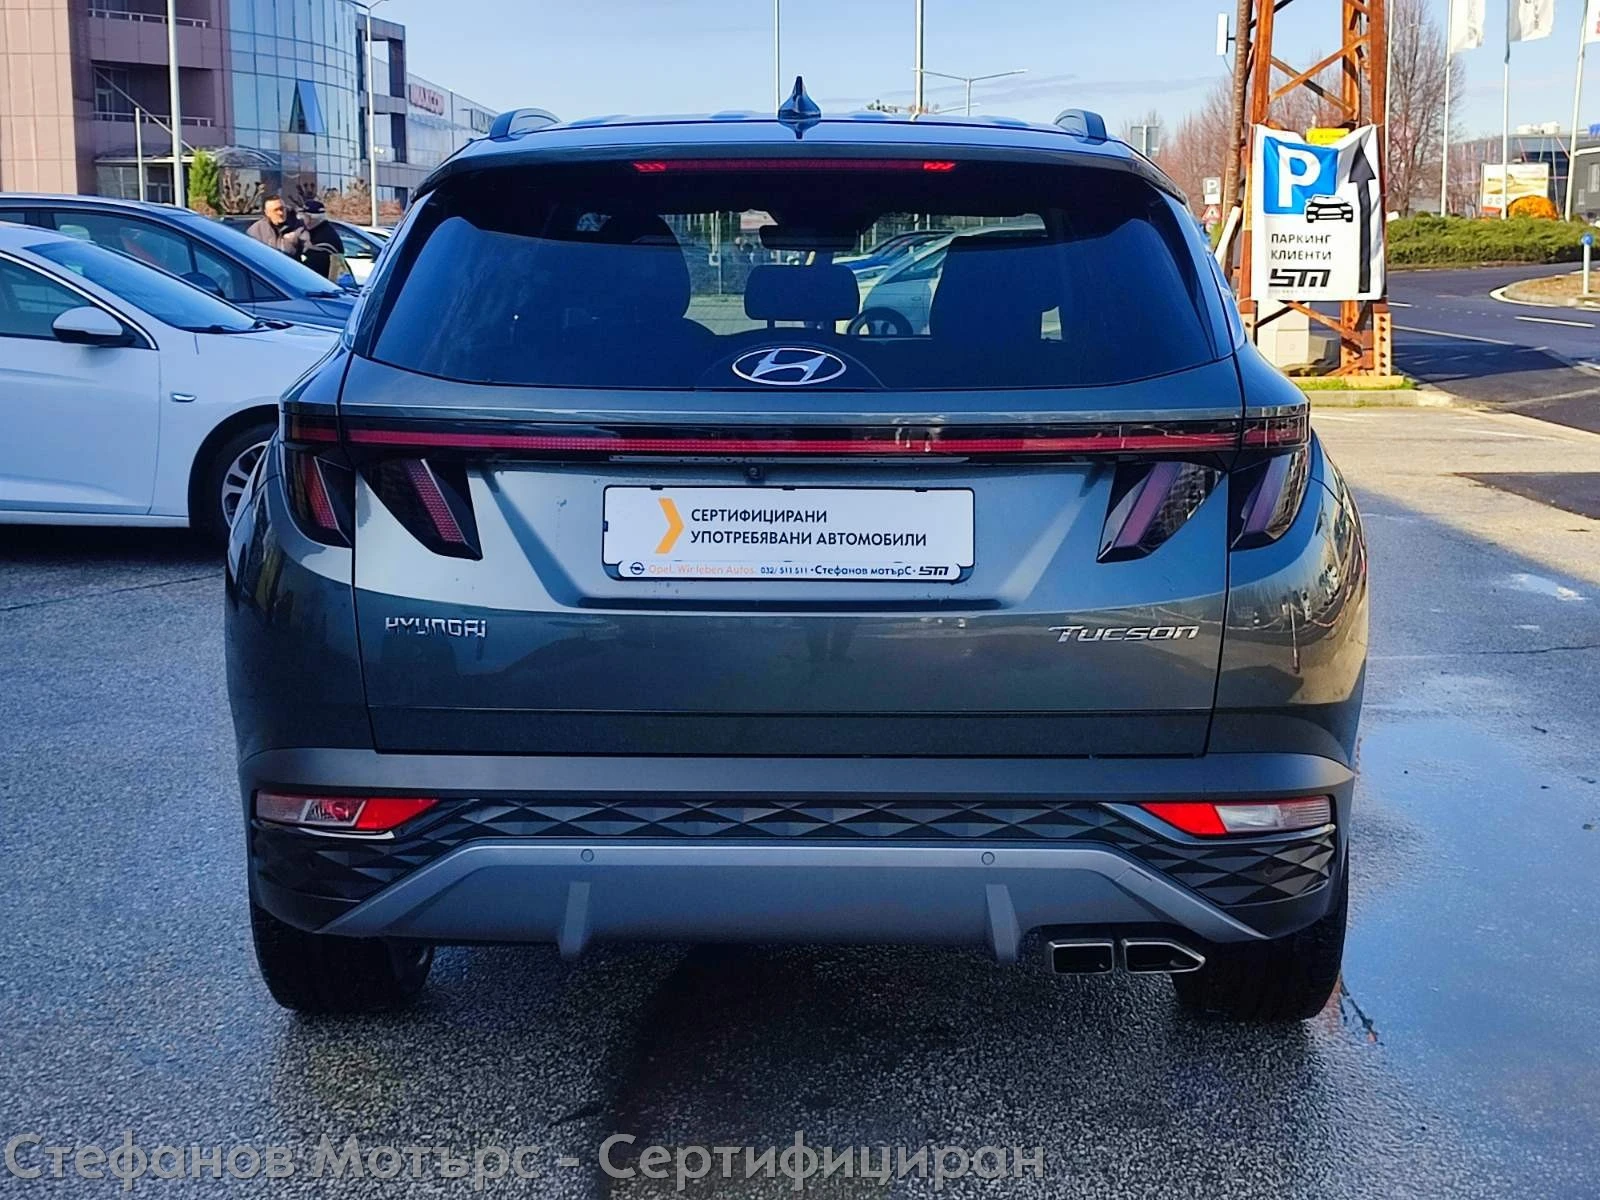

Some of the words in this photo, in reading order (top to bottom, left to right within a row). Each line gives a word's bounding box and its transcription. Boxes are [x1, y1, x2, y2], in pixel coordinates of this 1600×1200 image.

[1277, 145, 1320, 208] P
[1271, 233, 1332, 244] ПАРКИНГ
[1271, 249, 1332, 260] КЛИЕНТИ
[691, 508, 827, 524] СЕРТИФИЦИРАНИ
[690, 530, 813, 545] УПОТРЕБЯВАНИ
[816, 532, 927, 547] АВТОМОБИЛИ
[385, 617, 487, 638] HYUNDAI
